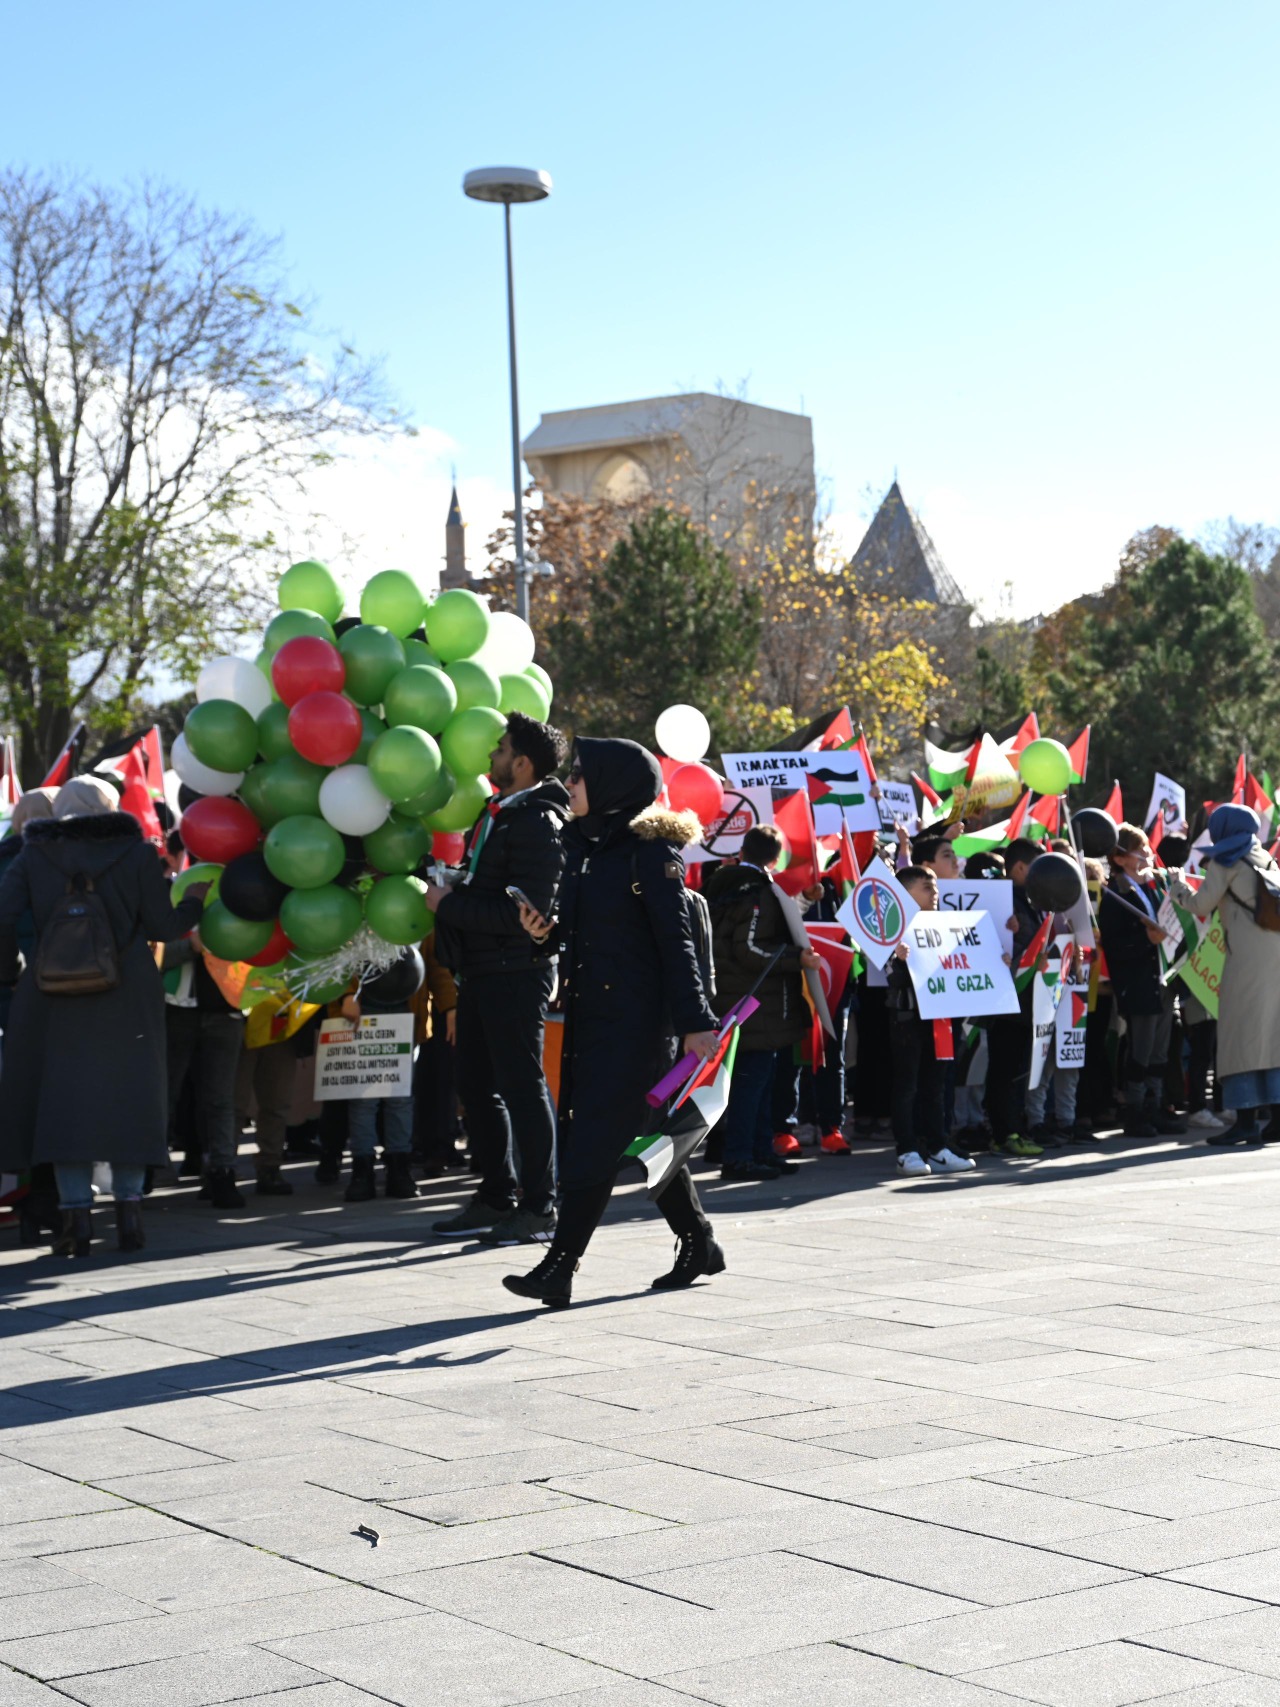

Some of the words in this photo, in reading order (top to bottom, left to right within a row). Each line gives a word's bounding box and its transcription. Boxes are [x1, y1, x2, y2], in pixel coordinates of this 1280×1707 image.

[736, 757, 809, 772] IRMAKTAN
[914, 928, 942, 948] END
[949, 927, 981, 946] THE
[938, 953, 971, 970] WAR
[927, 977, 946, 994] ON
[956, 973, 995, 992] GAZA
[364, 1030, 373, 1039] TO
[375, 1029, 395, 1039] NEED
[342, 1046, 356, 1056] YOU
[324, 1061, 334, 1071] UP
[334, 1060, 356, 1070] STAND
[357, 1060, 367, 1069] TO
[368, 1059, 399, 1068] MUSLIM
[330, 1075, 339, 1086] TO
[340, 1074, 358, 1085] NEED
[384, 1073, 400, 1084] YOU
